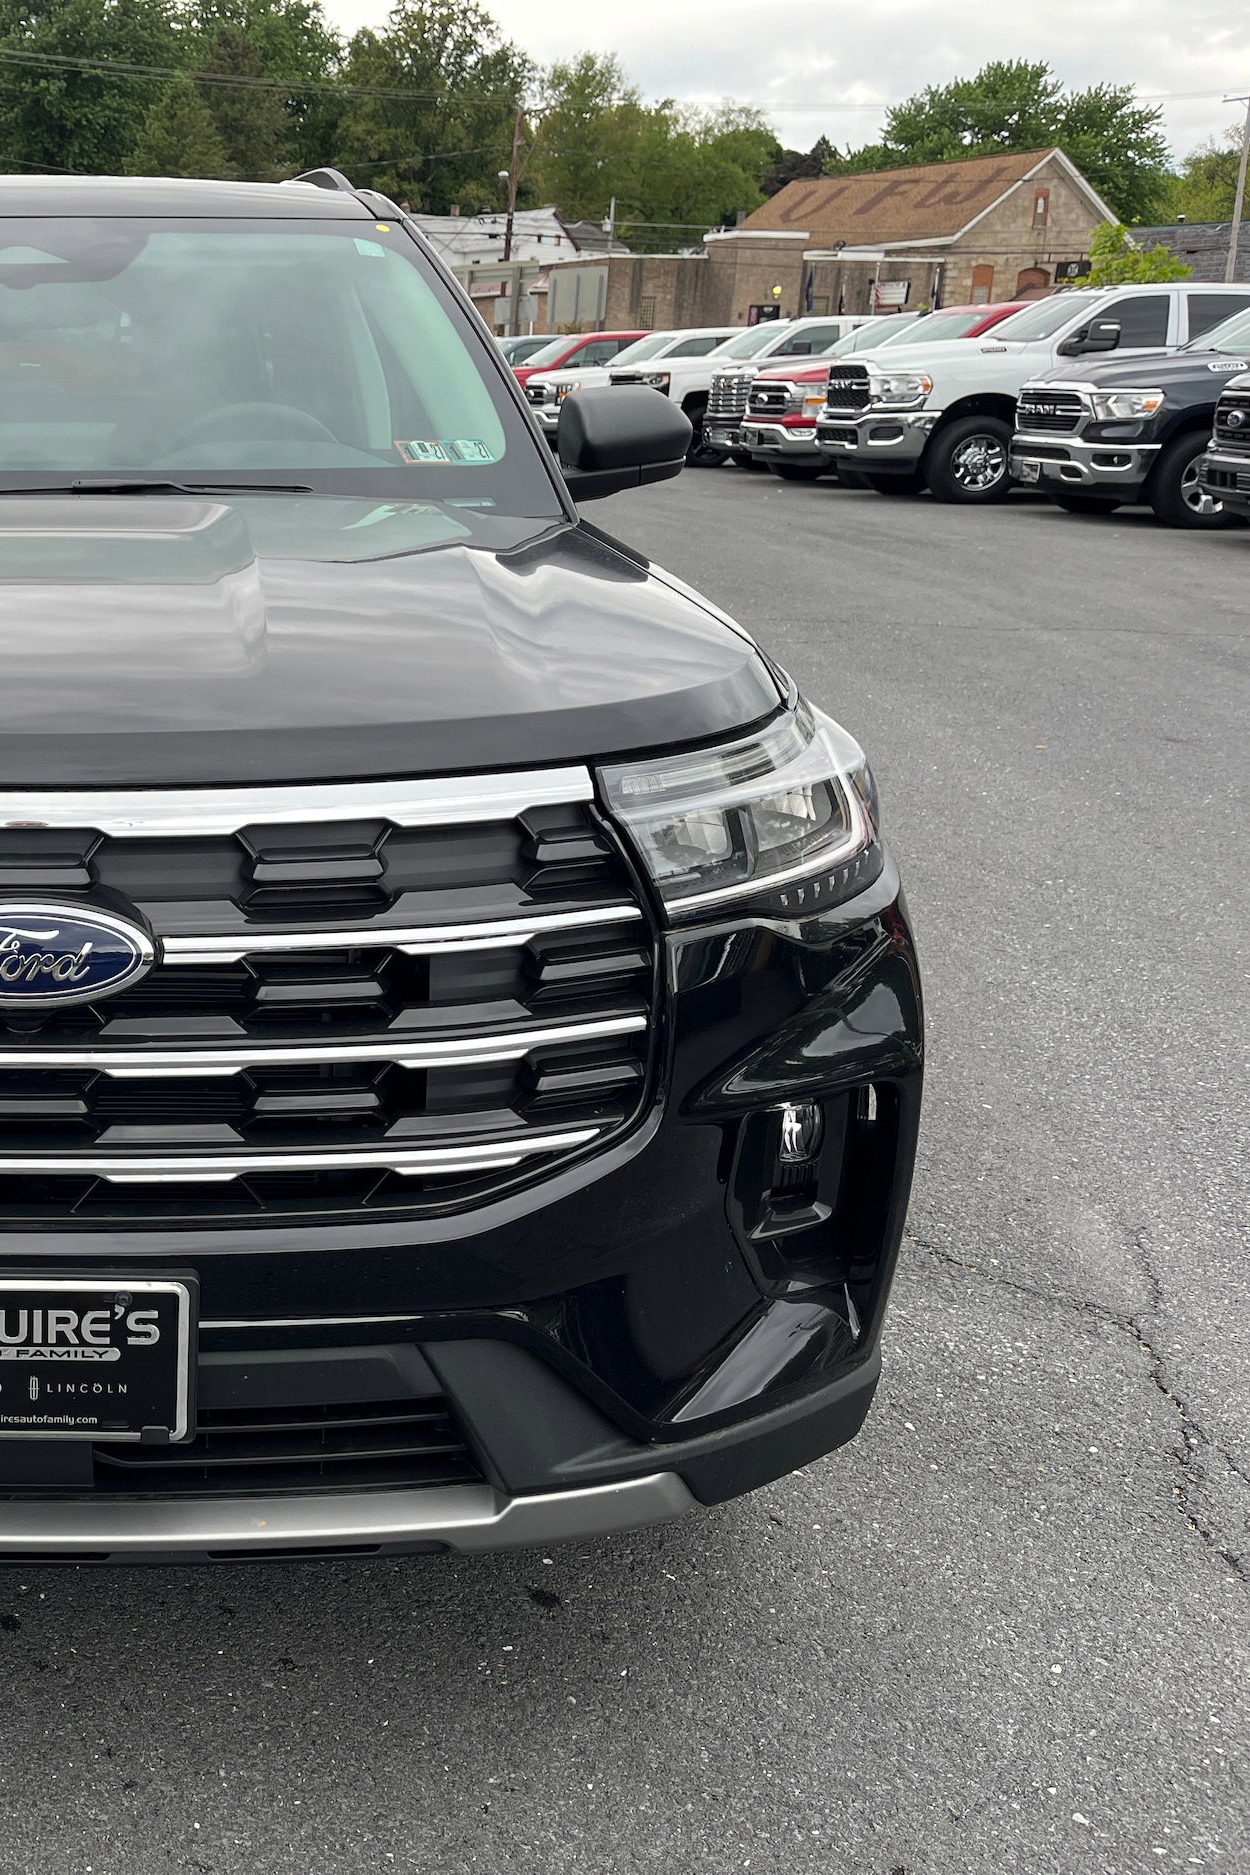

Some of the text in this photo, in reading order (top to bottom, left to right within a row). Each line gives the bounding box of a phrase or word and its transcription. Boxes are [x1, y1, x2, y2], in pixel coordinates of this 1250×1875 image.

[430, 443, 446, 460] 27
[473, 442, 490, 459] 27
[16, 1349, 109, 1358] FAMILY
[47, 1383, 127, 1394] LINCOLN
